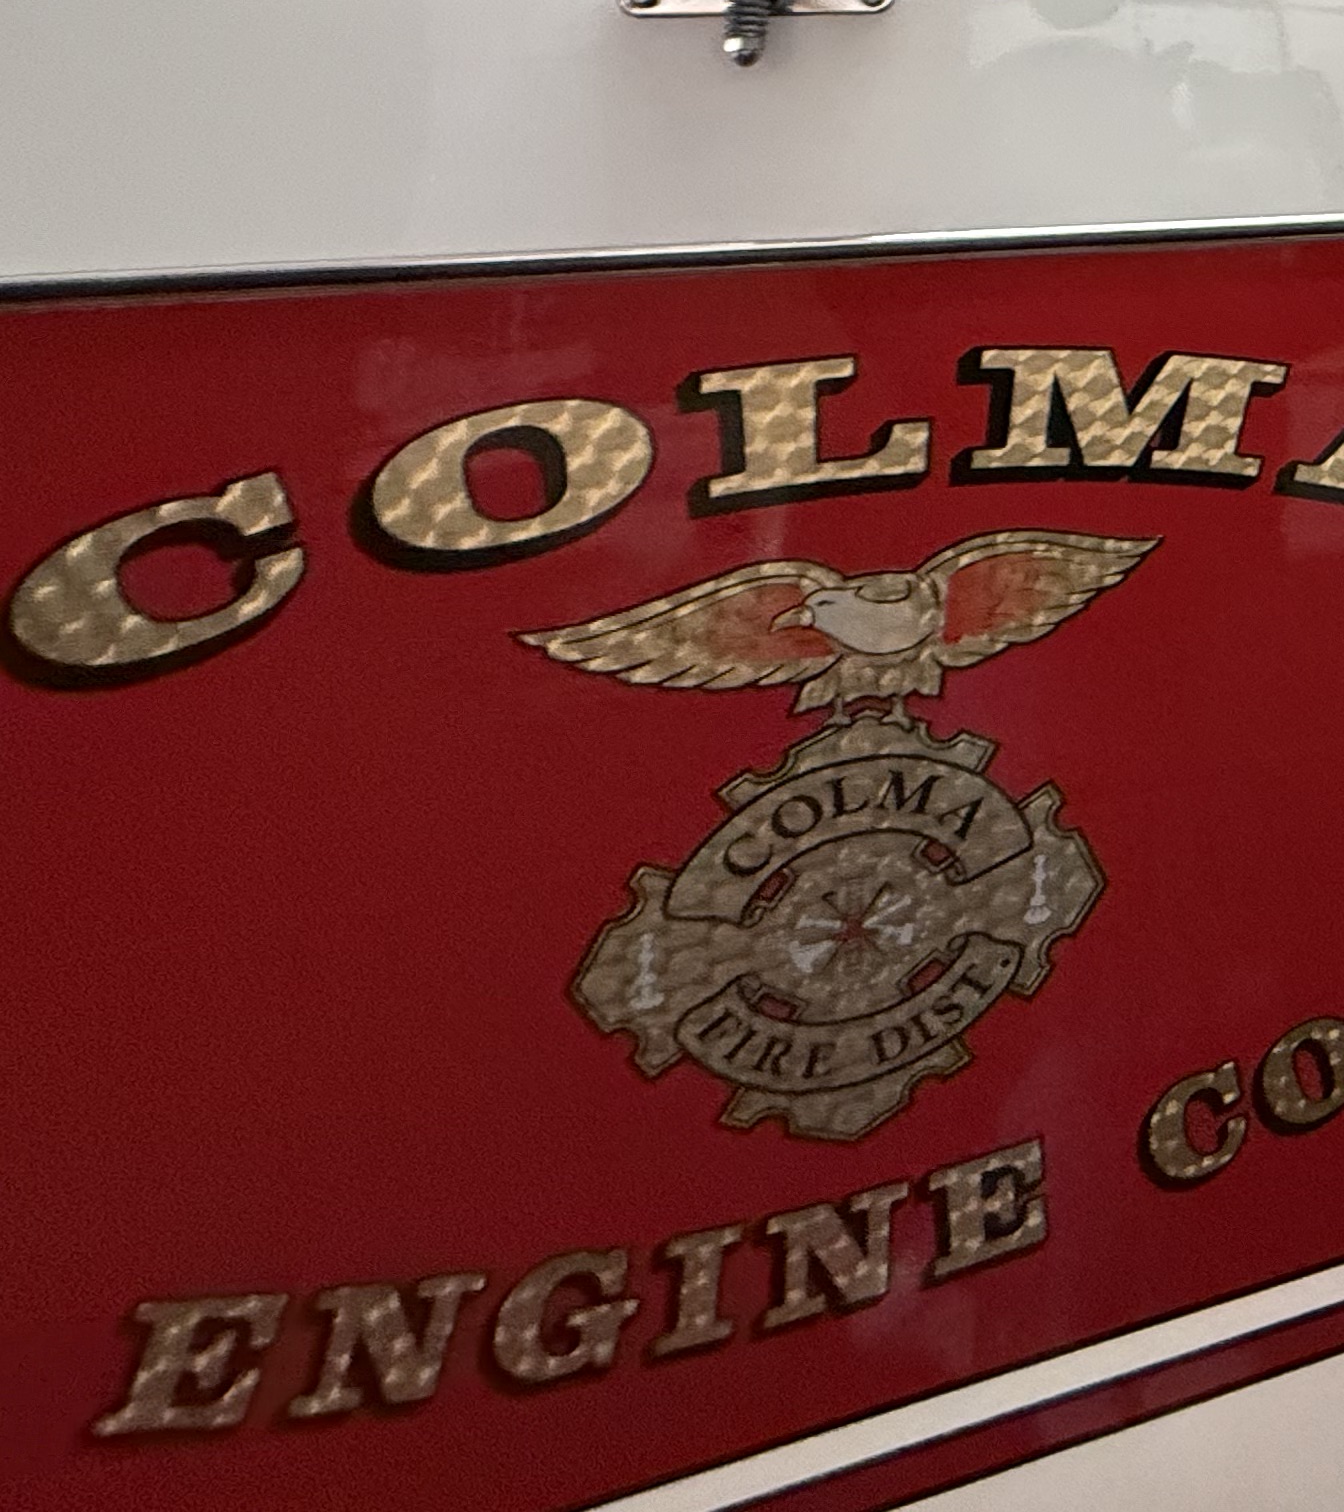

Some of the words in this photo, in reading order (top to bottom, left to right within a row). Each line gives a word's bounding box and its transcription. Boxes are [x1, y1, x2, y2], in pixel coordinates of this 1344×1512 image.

[723, 769, 989, 877] COLMA
[696, 1006, 837, 1080] FIRE
[88, 1137, 1050, 1440] ENGINE
